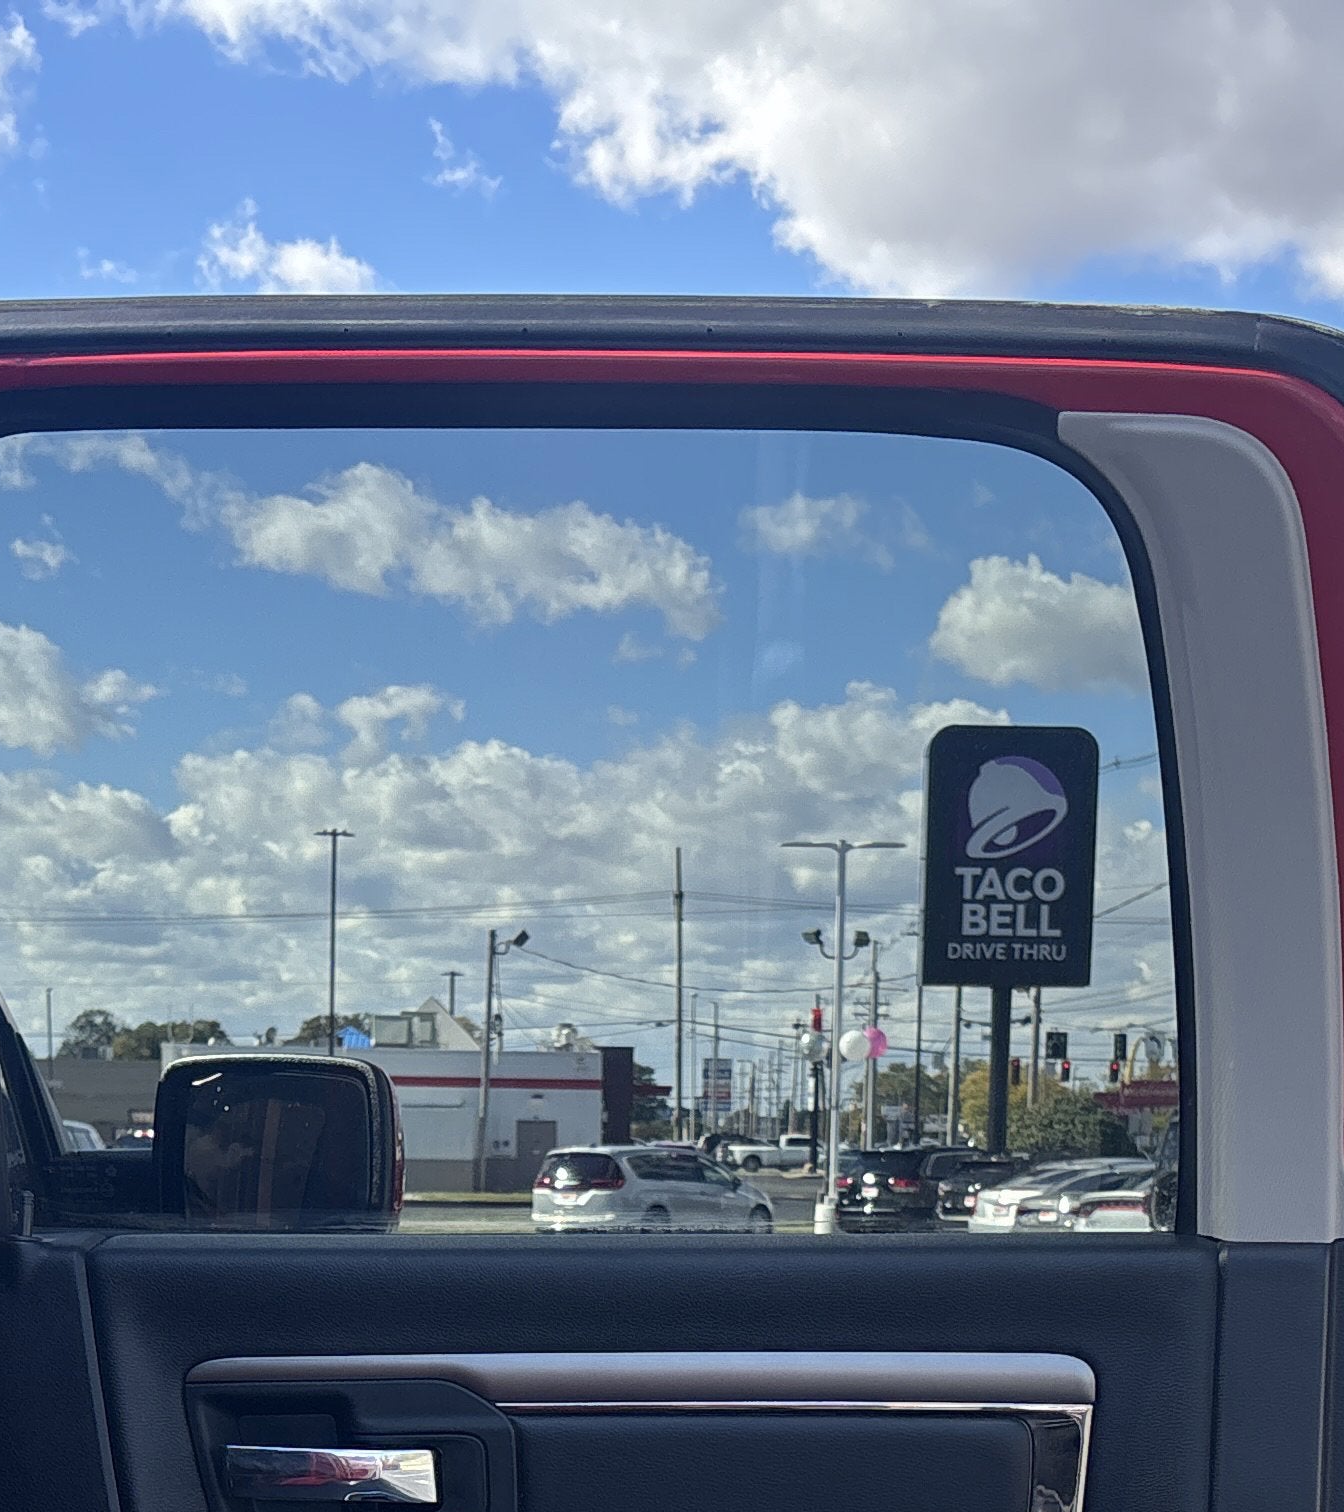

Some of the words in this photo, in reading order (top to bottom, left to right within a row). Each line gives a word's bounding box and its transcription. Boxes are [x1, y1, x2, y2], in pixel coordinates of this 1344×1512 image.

[954, 867, 1065, 901] TACO
[961, 903, 1062, 937] BELL
[947, 942, 1007, 960] DRIVE
[1011, 943, 1067, 961] THRU
